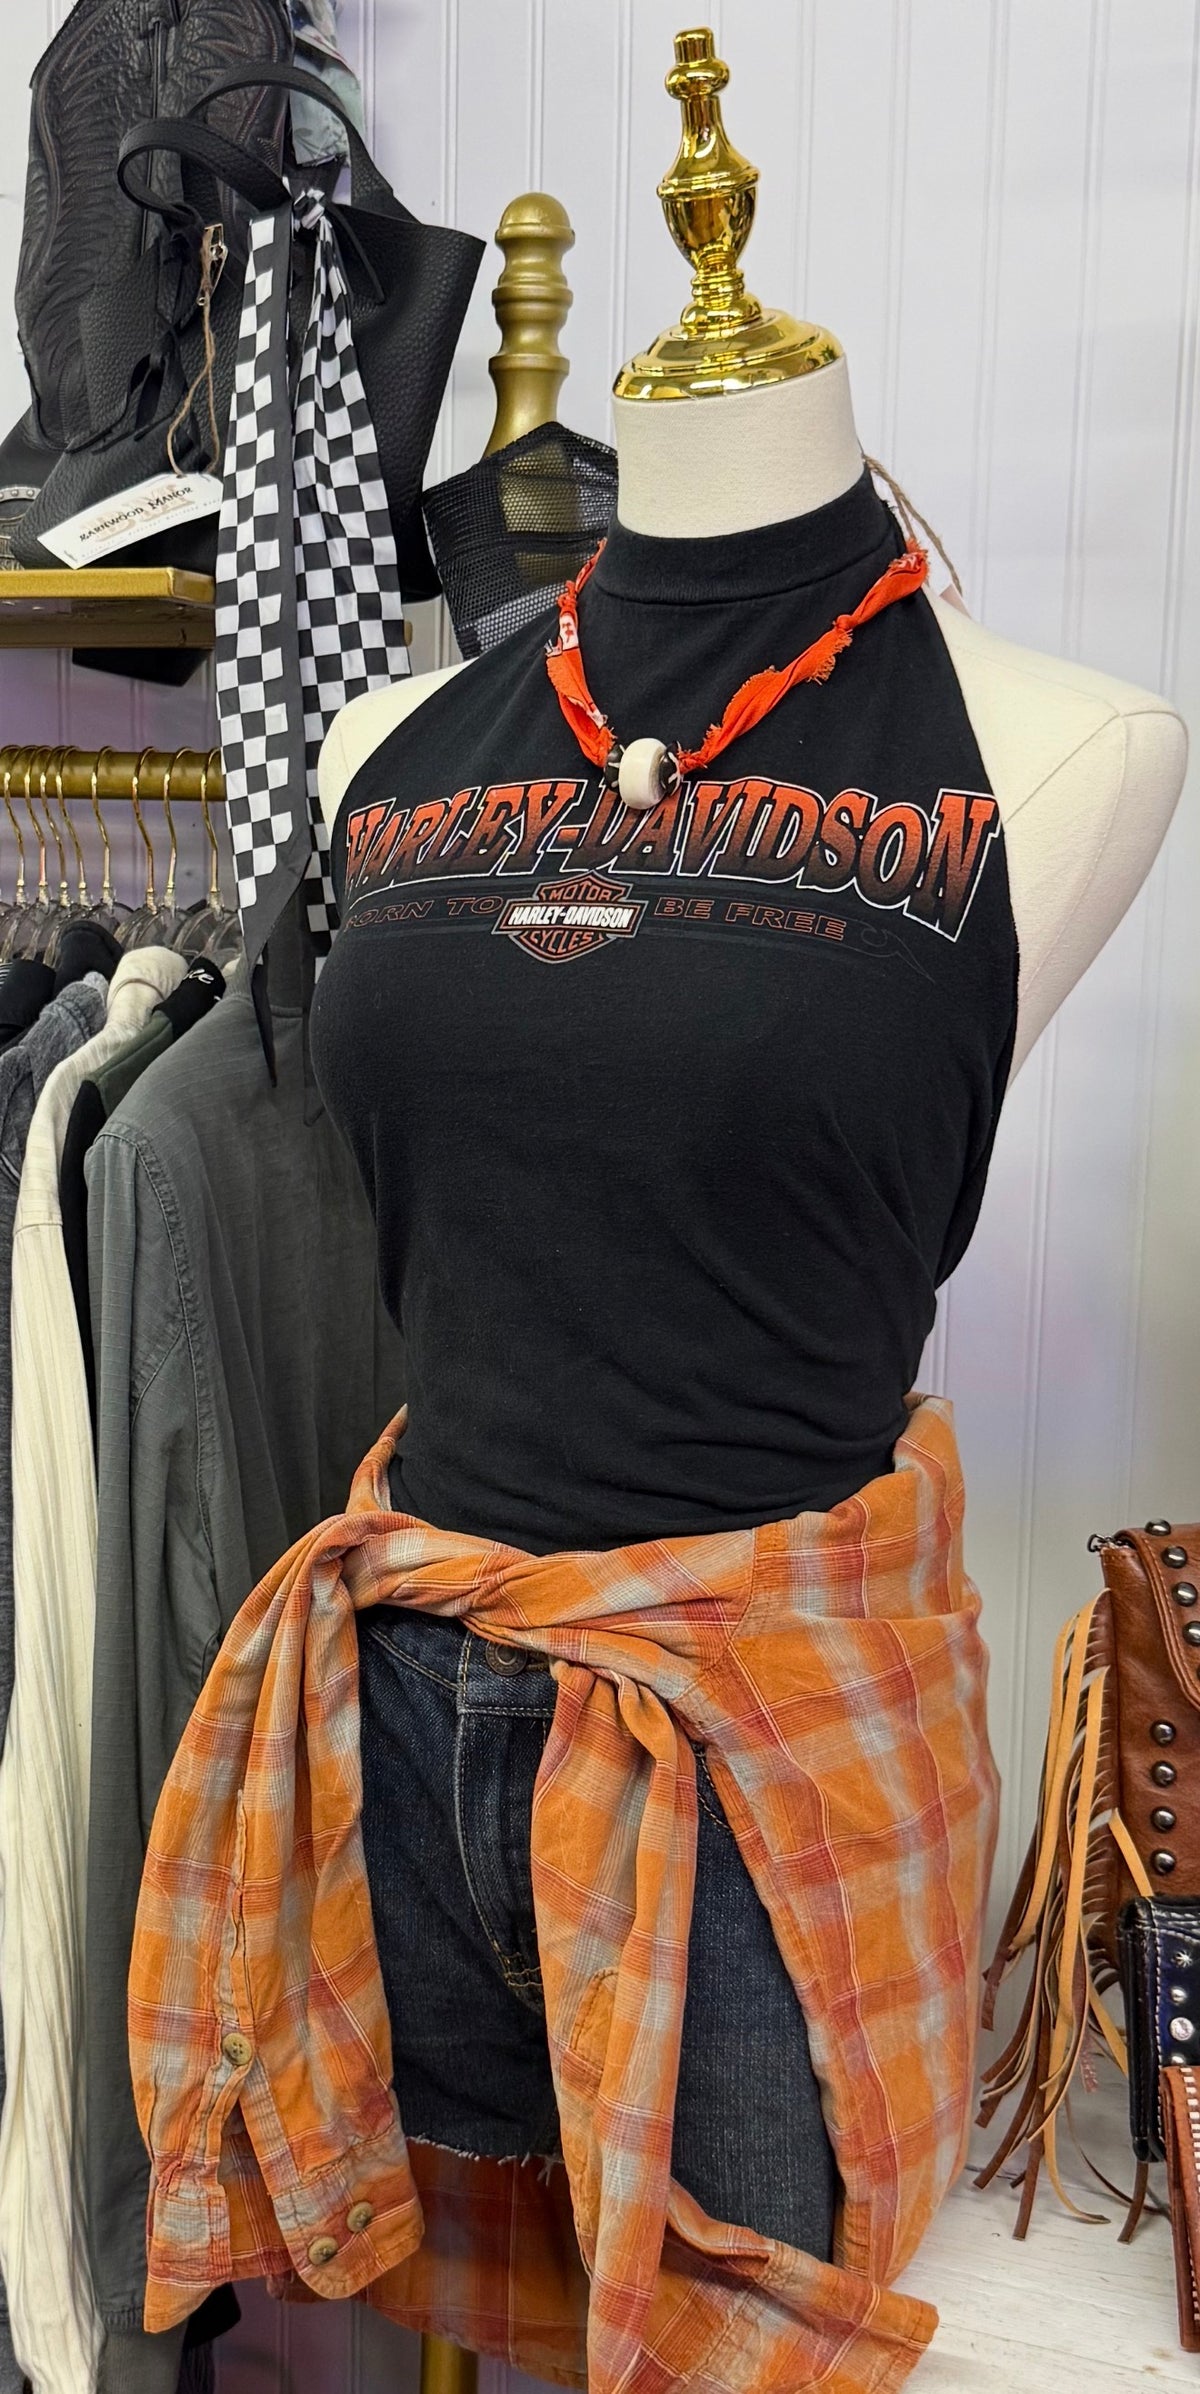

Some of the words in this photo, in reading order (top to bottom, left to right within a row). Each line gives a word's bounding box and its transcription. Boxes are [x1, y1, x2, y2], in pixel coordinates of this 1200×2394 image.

[346, 776, 1000, 942] HARLEY-DAVIDSON
[550, 880, 611, 901] MOTOR
[447, 897, 504, 915] TO
[653, 897, 715, 920] BE
[724, 902, 847, 942] FREE
[507, 905, 634, 929] HARLEY-DAVIDSON
[529, 929, 594, 954] CYCLES
